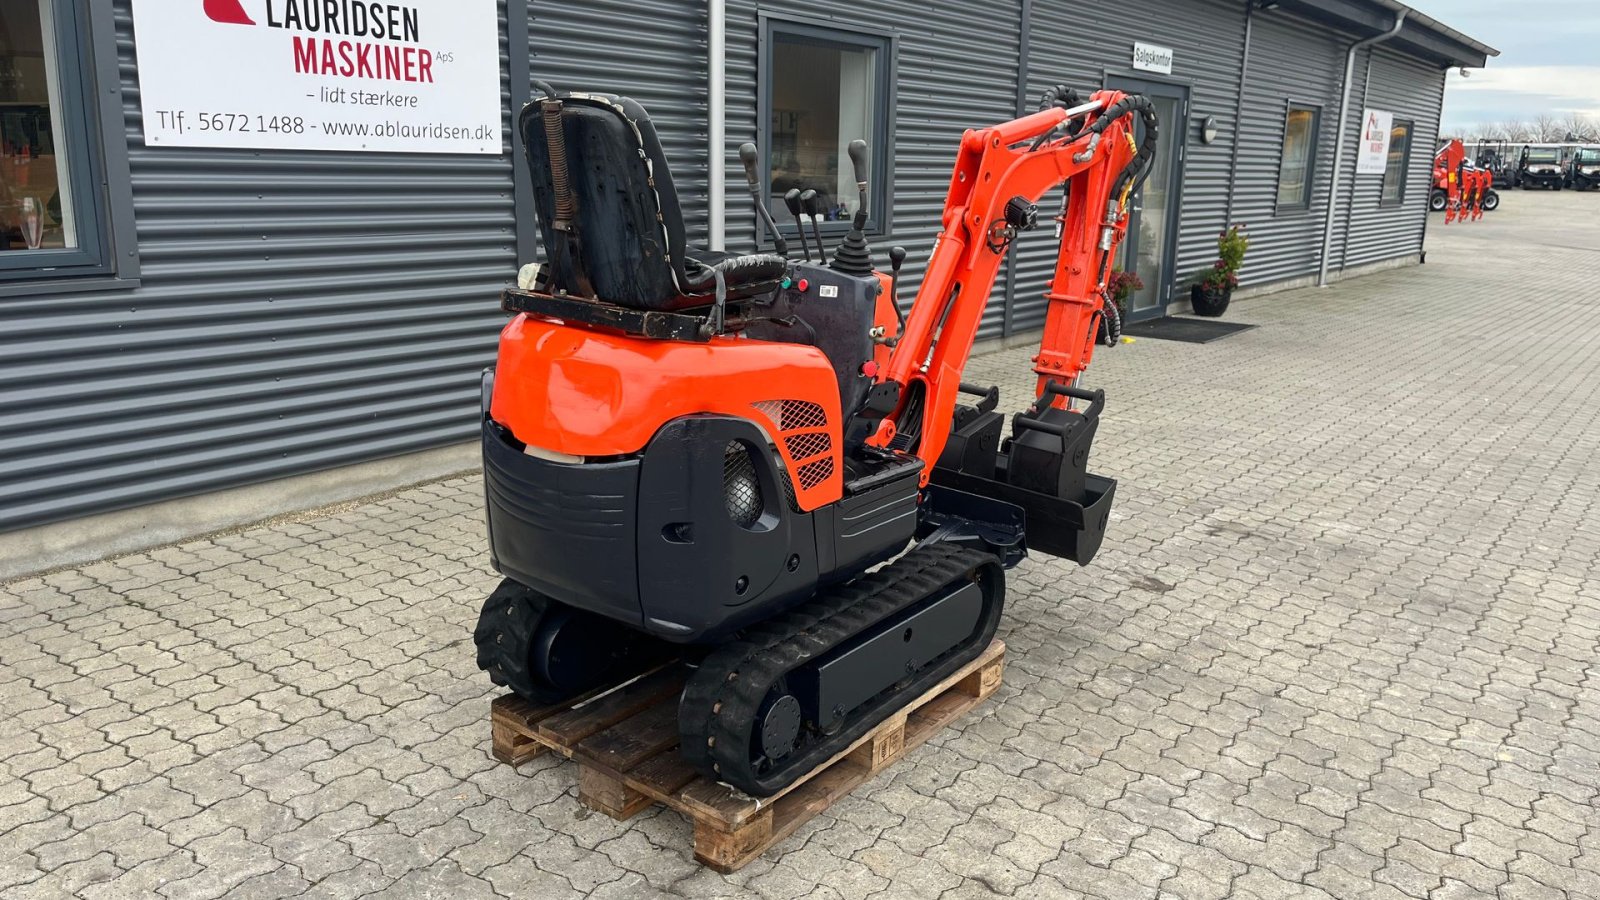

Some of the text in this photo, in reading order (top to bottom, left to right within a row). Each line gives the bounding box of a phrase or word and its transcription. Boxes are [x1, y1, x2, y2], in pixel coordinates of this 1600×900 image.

[265, 0, 420, 43] LAURIDSEN
[292, 36, 454, 84] MASKINER ApS
[1135, 47, 1171, 67] Salgskontor
[320, 86, 346, 104] lidt
[351, 89, 418, 108] stærkere
[155, 110, 191, 135] Tlf.
[198, 112, 251, 133] 5672
[256, 115, 305, 135] 1488
[322, 120, 494, 140] www.ablauridsen.dk
